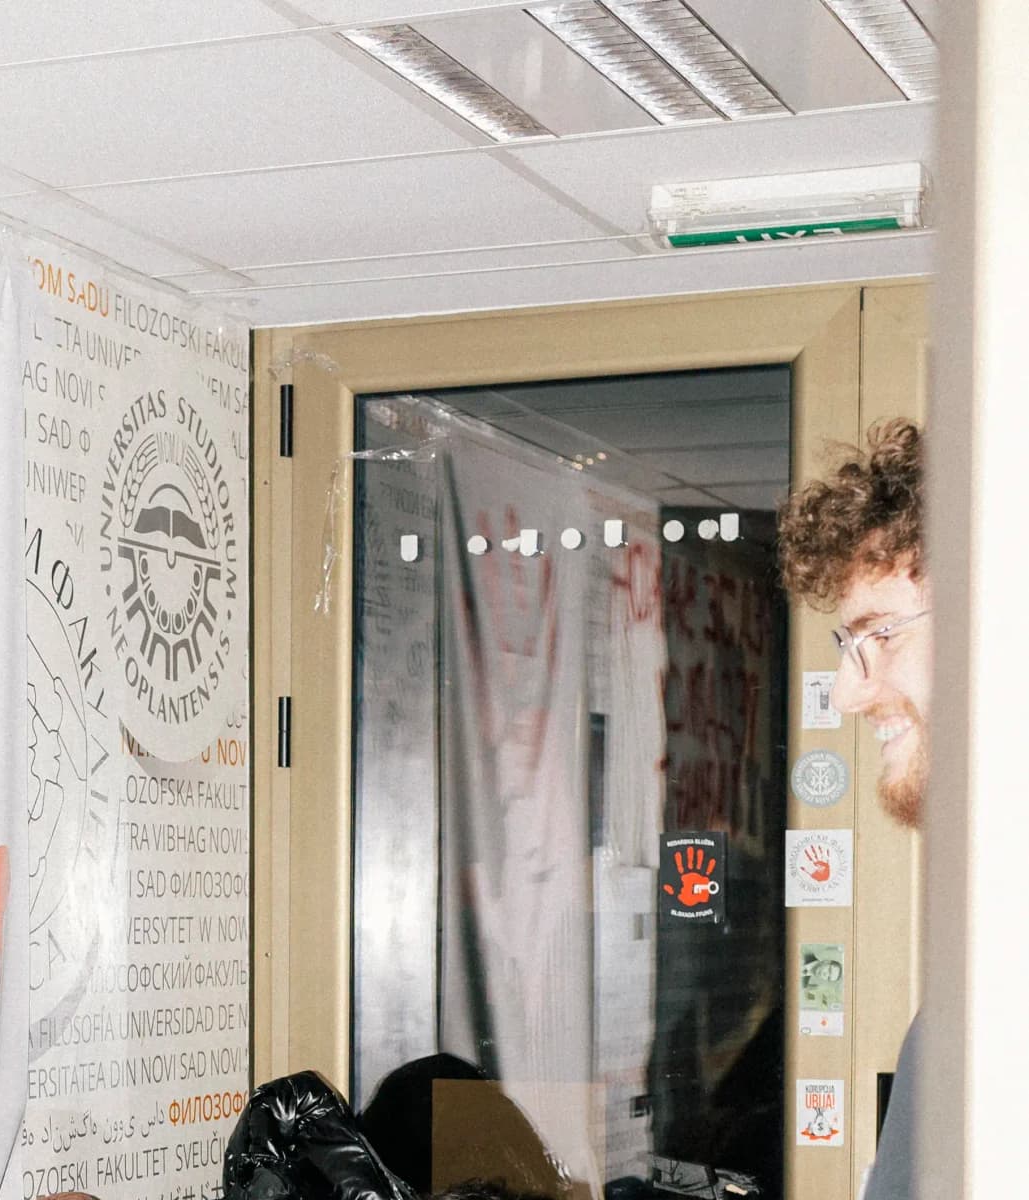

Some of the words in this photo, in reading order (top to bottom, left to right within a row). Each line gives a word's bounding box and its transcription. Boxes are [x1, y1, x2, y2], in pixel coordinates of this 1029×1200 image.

[28, 256, 62, 298] OM
[67, 272, 109, 317] SADU
[115, 294, 201, 354] FILOZOFSKI
[55, 367, 92, 409] NOVI
[38, 413, 71, 449] SAD
[99, 389, 167, 571] UNIVERSITAS
[177, 396, 237, 599] STUDIORUM
[105, 605, 230, 725] NEOPLANTENSIS
[153, 823, 206, 853] VIBHAG
[210, 827, 242, 854] NOVI
[136, 869, 166, 898] SAD
[199, 916, 212, 943] W
[119, 1006, 213, 1041] UNIVERSIDAD
[218, 1004, 234, 1031] DE
[28, 1061, 105, 1100] ERSITATEA
[110, 1057, 136, 1090] DIN
[141, 1052, 176, 1085] NOVI
[180, 1051, 206, 1081] SAD
[211, 1047, 241, 1076] NOVI
[97, 1147, 168, 1187] FAKULTET
